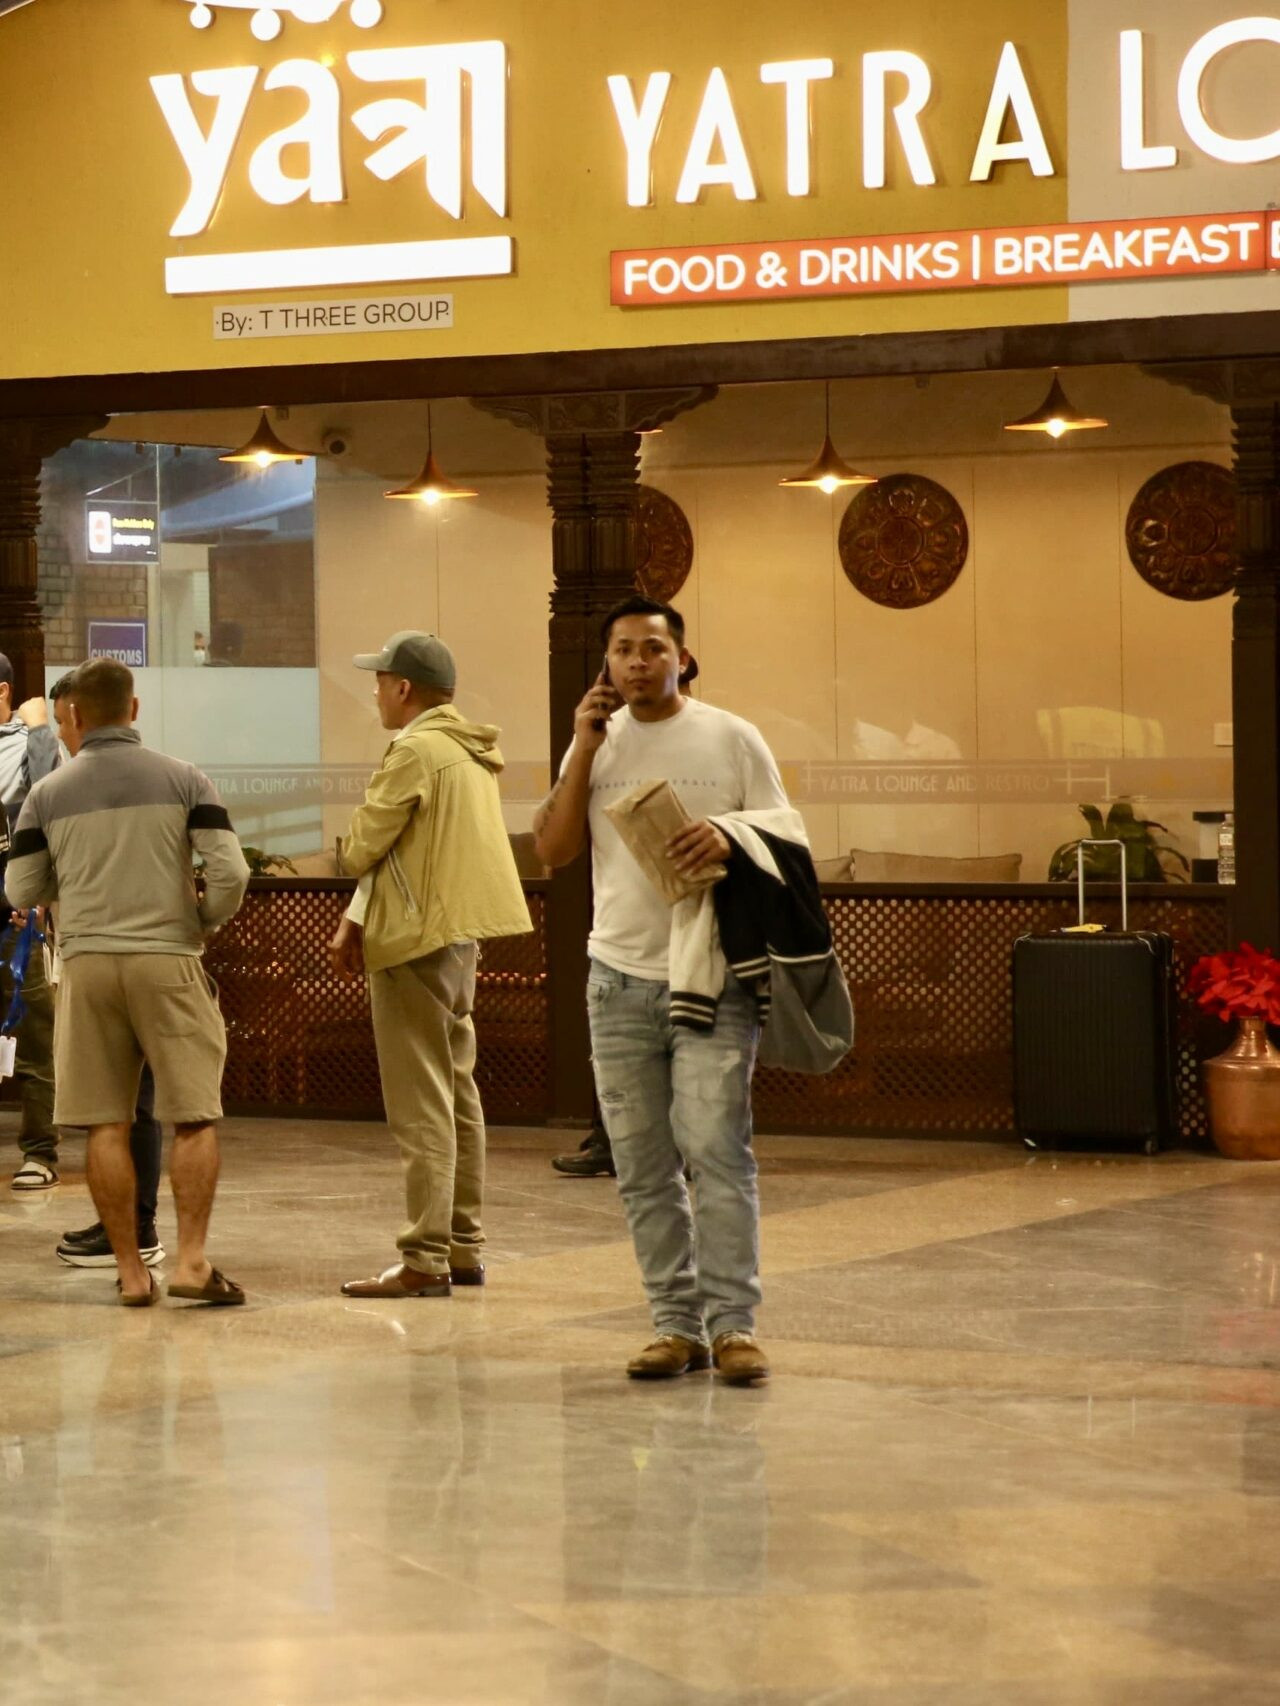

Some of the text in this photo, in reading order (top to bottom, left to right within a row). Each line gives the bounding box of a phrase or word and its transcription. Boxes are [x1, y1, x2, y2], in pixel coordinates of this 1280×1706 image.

[607, 41, 1056, 207] YATRA
[624, 255, 746, 295] FOOD
[755, 251, 788, 289] &
[799, 240, 960, 286] DRINKS
[993, 222, 1261, 275] BREAKFAST
[221, 301, 449, 336] By: T THREE GROUP
[243, 776, 298, 794] LOUNGE
[822, 775, 869, 792] YATRA
[875, 774, 938, 792] LOUNGE
[946, 774, 976, 792] AND
